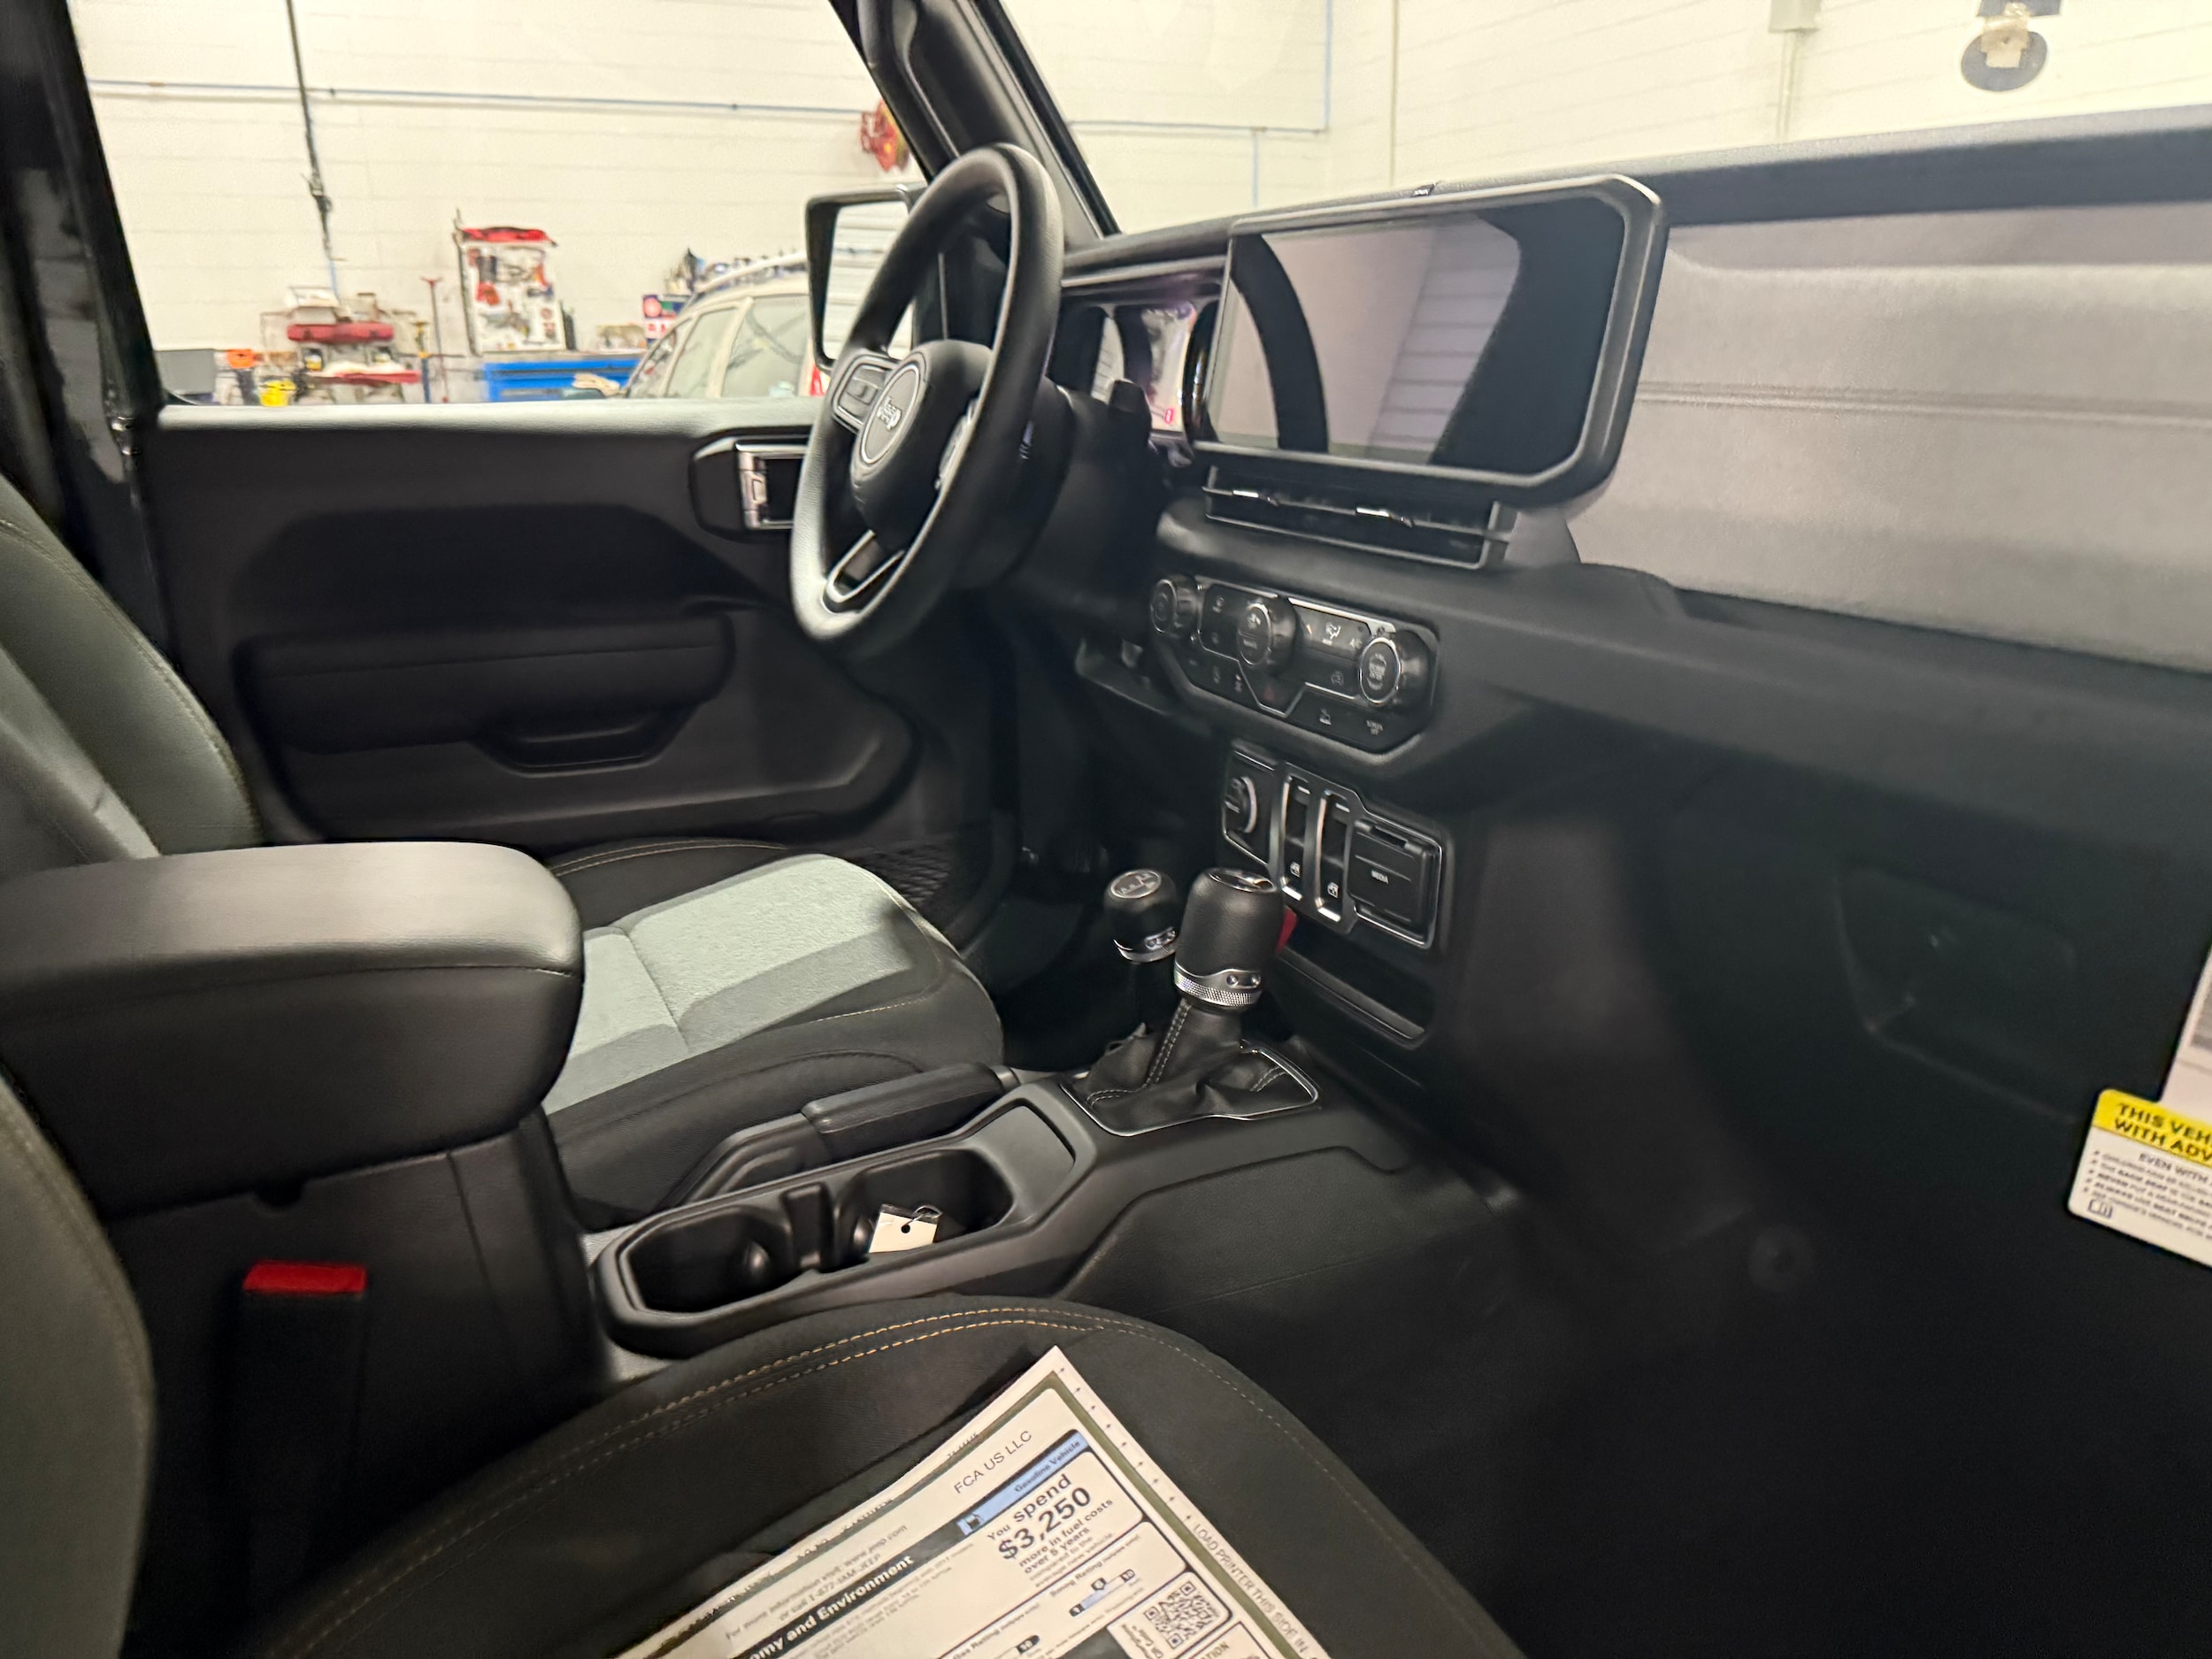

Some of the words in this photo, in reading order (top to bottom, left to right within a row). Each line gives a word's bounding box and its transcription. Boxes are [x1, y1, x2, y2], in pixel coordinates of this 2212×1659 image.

[2114, 1118, 2166, 1146] WITH
[2170, 1140, 2212, 1161] ADV
[2116, 1102, 2164, 1128] THIS
[954, 1469, 984, 1494] FCA
[984, 1452, 1004, 1471] US
[1004, 1430, 1033, 1455] LLC
[1014, 1464, 1051, 1493] Gasoline
[1051, 1440, 1080, 1466] Vehicle
[987, 1523, 1011, 1541] You
[1013, 1473, 1072, 1524] spend
[997, 1486, 1091, 1561] $3,250
[1018, 1544, 1048, 1568] more
[1049, 1534, 1062, 1548] in
[1062, 1517, 1084, 1540] fuel
[1084, 1499, 1113, 1522] costs
[1024, 1555, 1050, 1575] over
[1060, 1527, 1091, 1552] years
[1194, 1524, 1218, 1551] LOAD
[1216, 1549, 1255, 1590] PRINTER
[1252, 1588, 1276, 1613] THIS
[1273, 1612, 1298, 1639] SIDE
[787, 1615, 818, 1641] and
[817, 1555, 915, 1621] Environment
